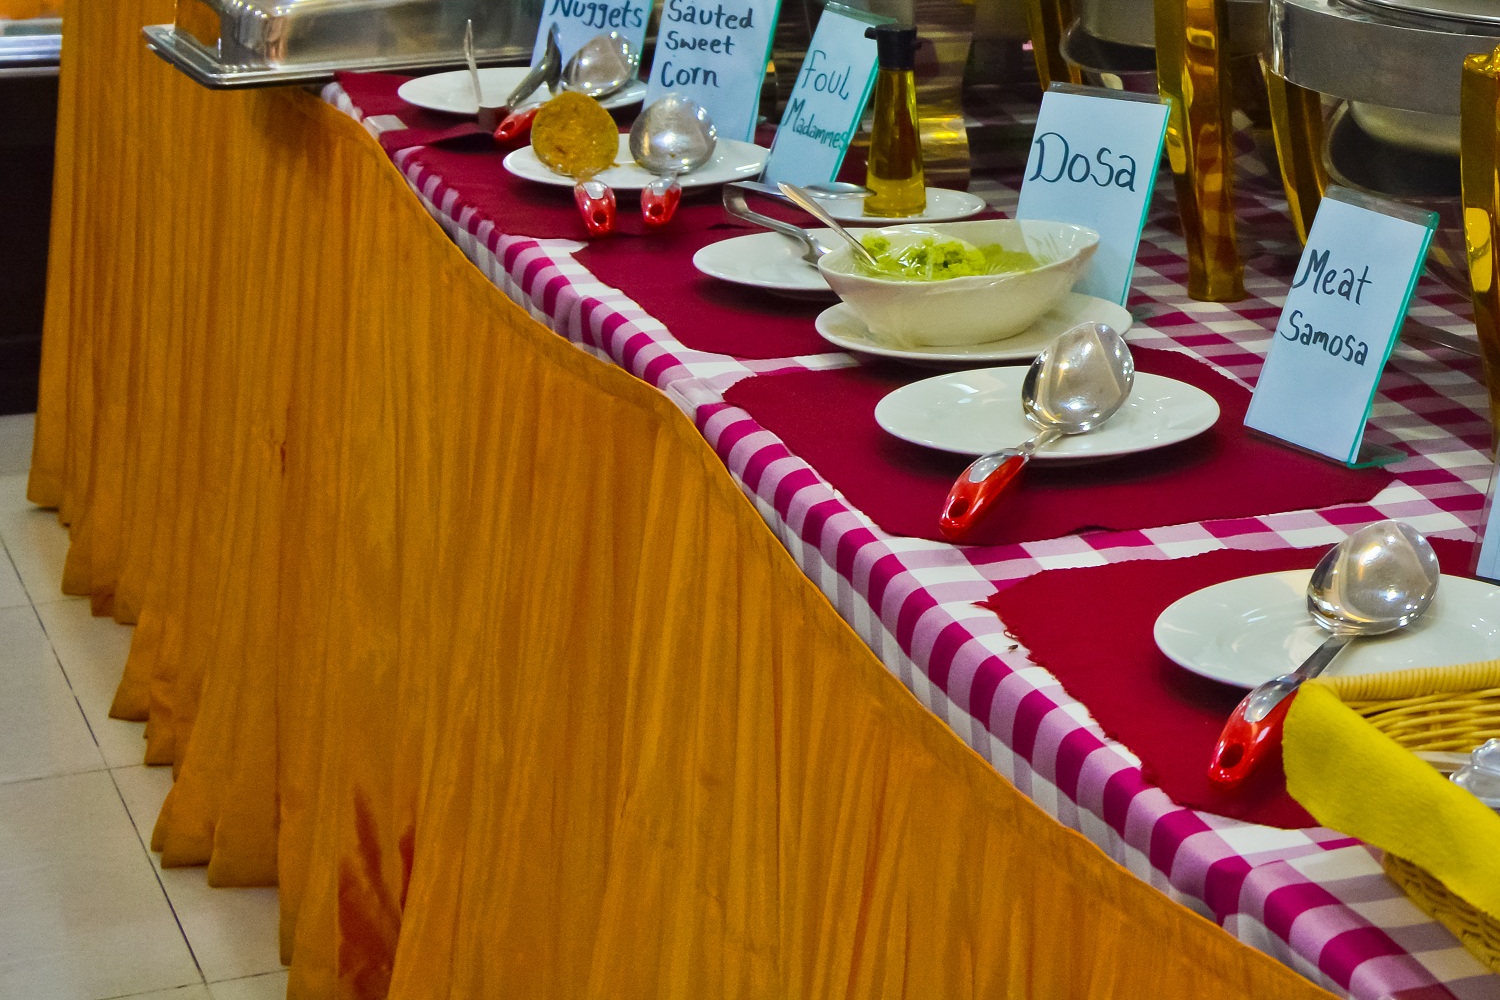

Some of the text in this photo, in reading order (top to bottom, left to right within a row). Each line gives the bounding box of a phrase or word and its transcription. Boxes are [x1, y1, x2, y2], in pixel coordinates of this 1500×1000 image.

[665, 30, 735, 56] Sweet
[661, 60, 720, 88] Corn
[1292, 249, 1373, 306] Meat
[1278, 309, 1370, 367] Samosa
